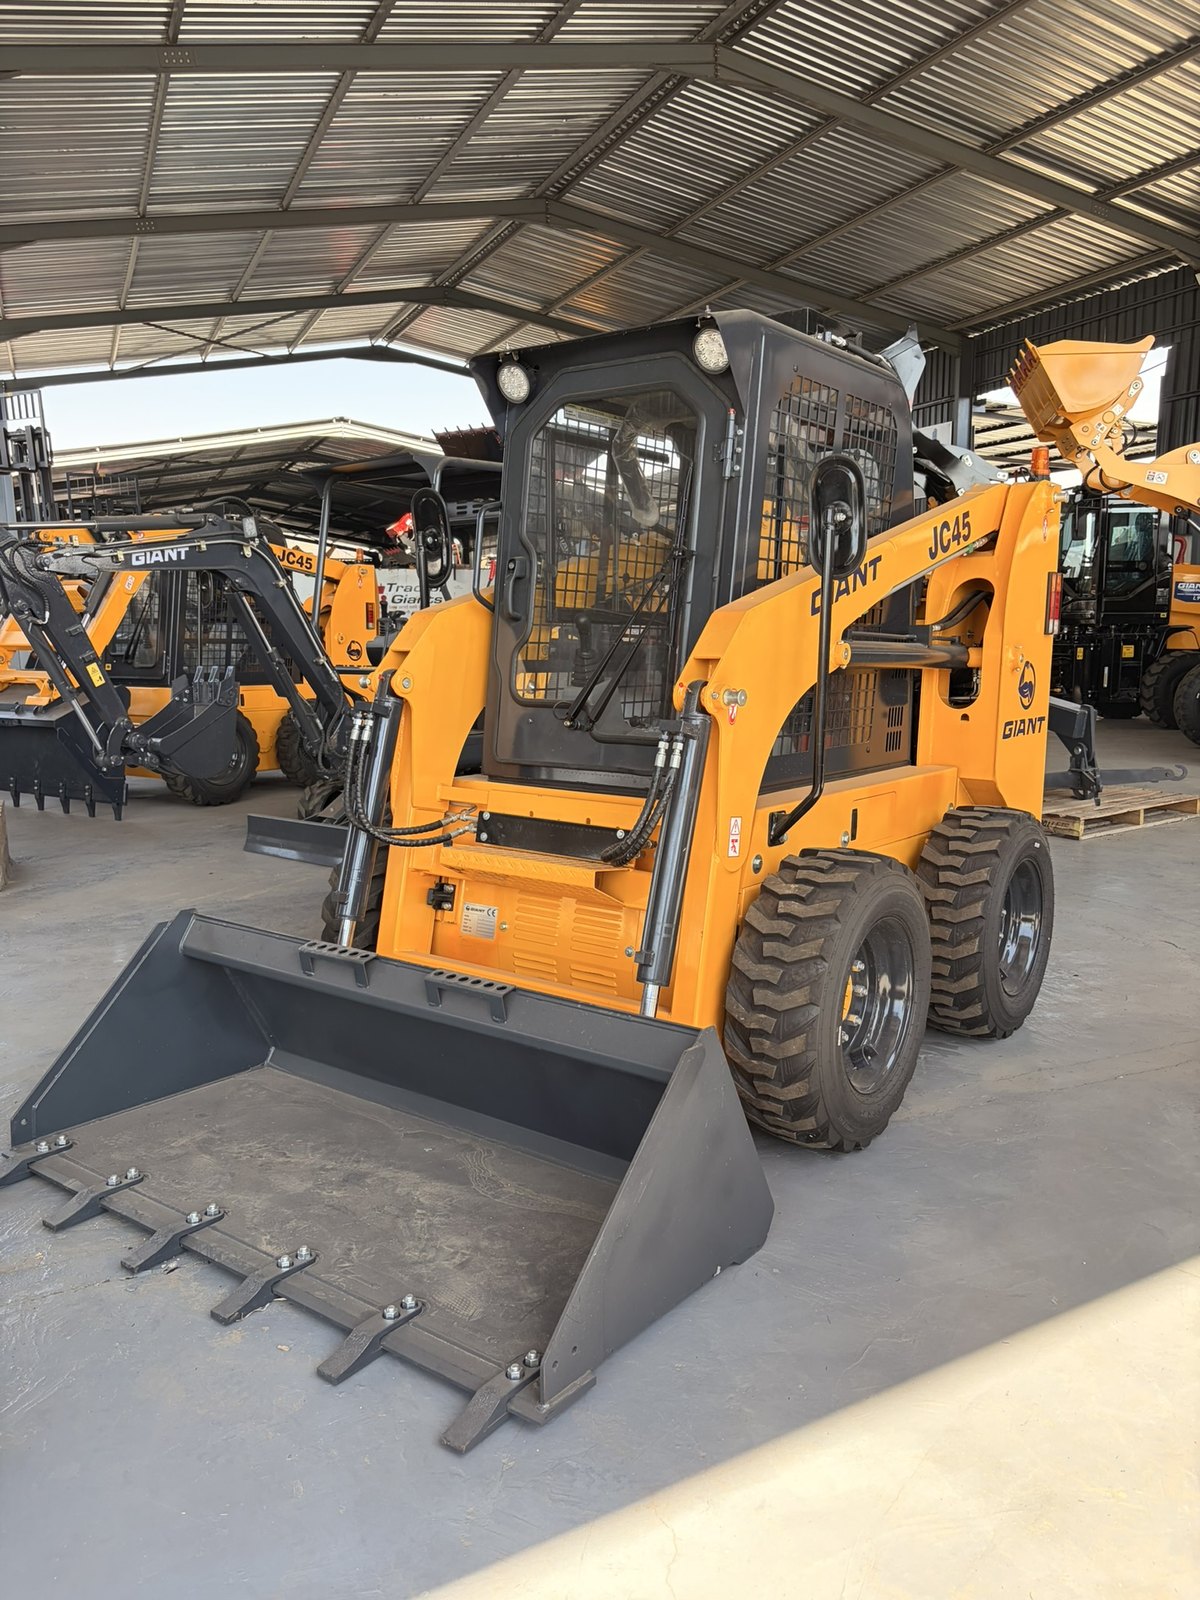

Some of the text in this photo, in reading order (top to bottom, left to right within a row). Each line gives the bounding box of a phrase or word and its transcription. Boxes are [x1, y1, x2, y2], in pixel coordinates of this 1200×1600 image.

[928, 511, 971, 560] JC45
[131, 547, 189, 566] GIANT
[277, 549, 313, 570] JC45
[811, 555, 882, 616] GANT
[1002, 716, 1046, 740] GIANT
